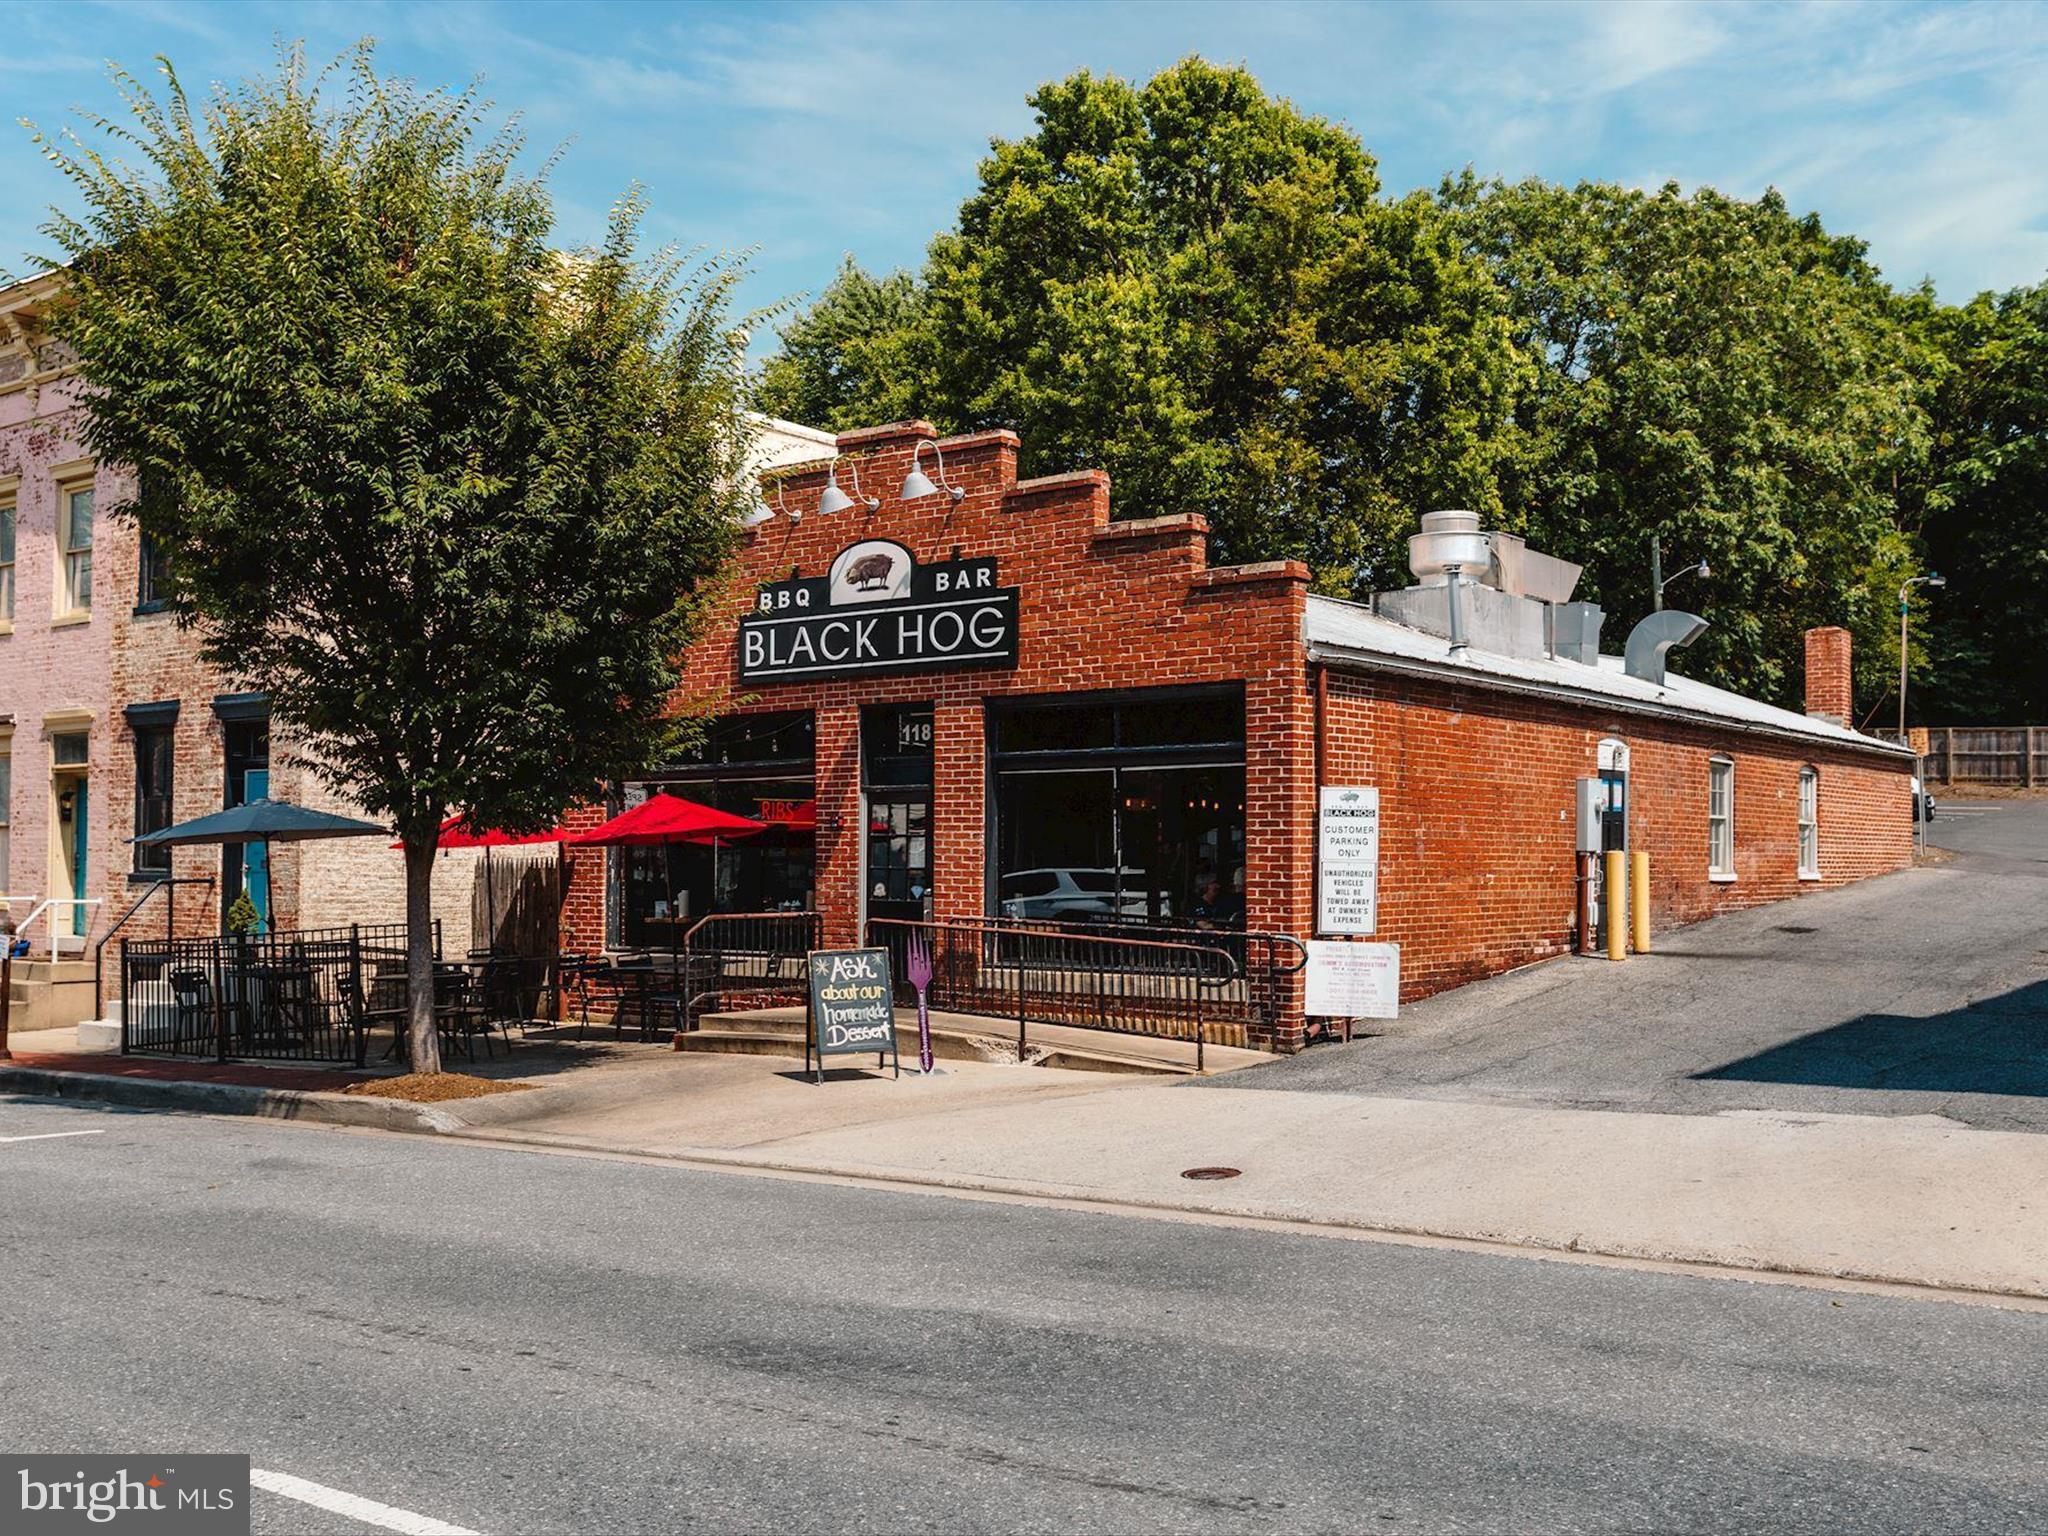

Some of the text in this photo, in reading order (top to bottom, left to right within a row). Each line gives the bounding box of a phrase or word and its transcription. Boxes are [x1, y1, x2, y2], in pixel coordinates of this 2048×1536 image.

[759, 568, 991, 610] BBQ BAR
[745, 607, 1006, 668] BLACK HOG
[902, 724, 931, 742] 118
[761, 800, 794, 820] RIBS
[1353, 809, 1375, 817] HOG
[1325, 826, 1374, 834] CUSTOMER
[1330, 837, 1369, 846] PARKING
[1338, 849, 1360, 857] ONLY
[1327, 897, 1348, 905] TOWED
[1333, 916, 1362, 924] EXPENSE
[821, 983, 886, 1000] about our
[822, 1002, 889, 1025] homemade
[827, 1021, 891, 1047] Dessert
